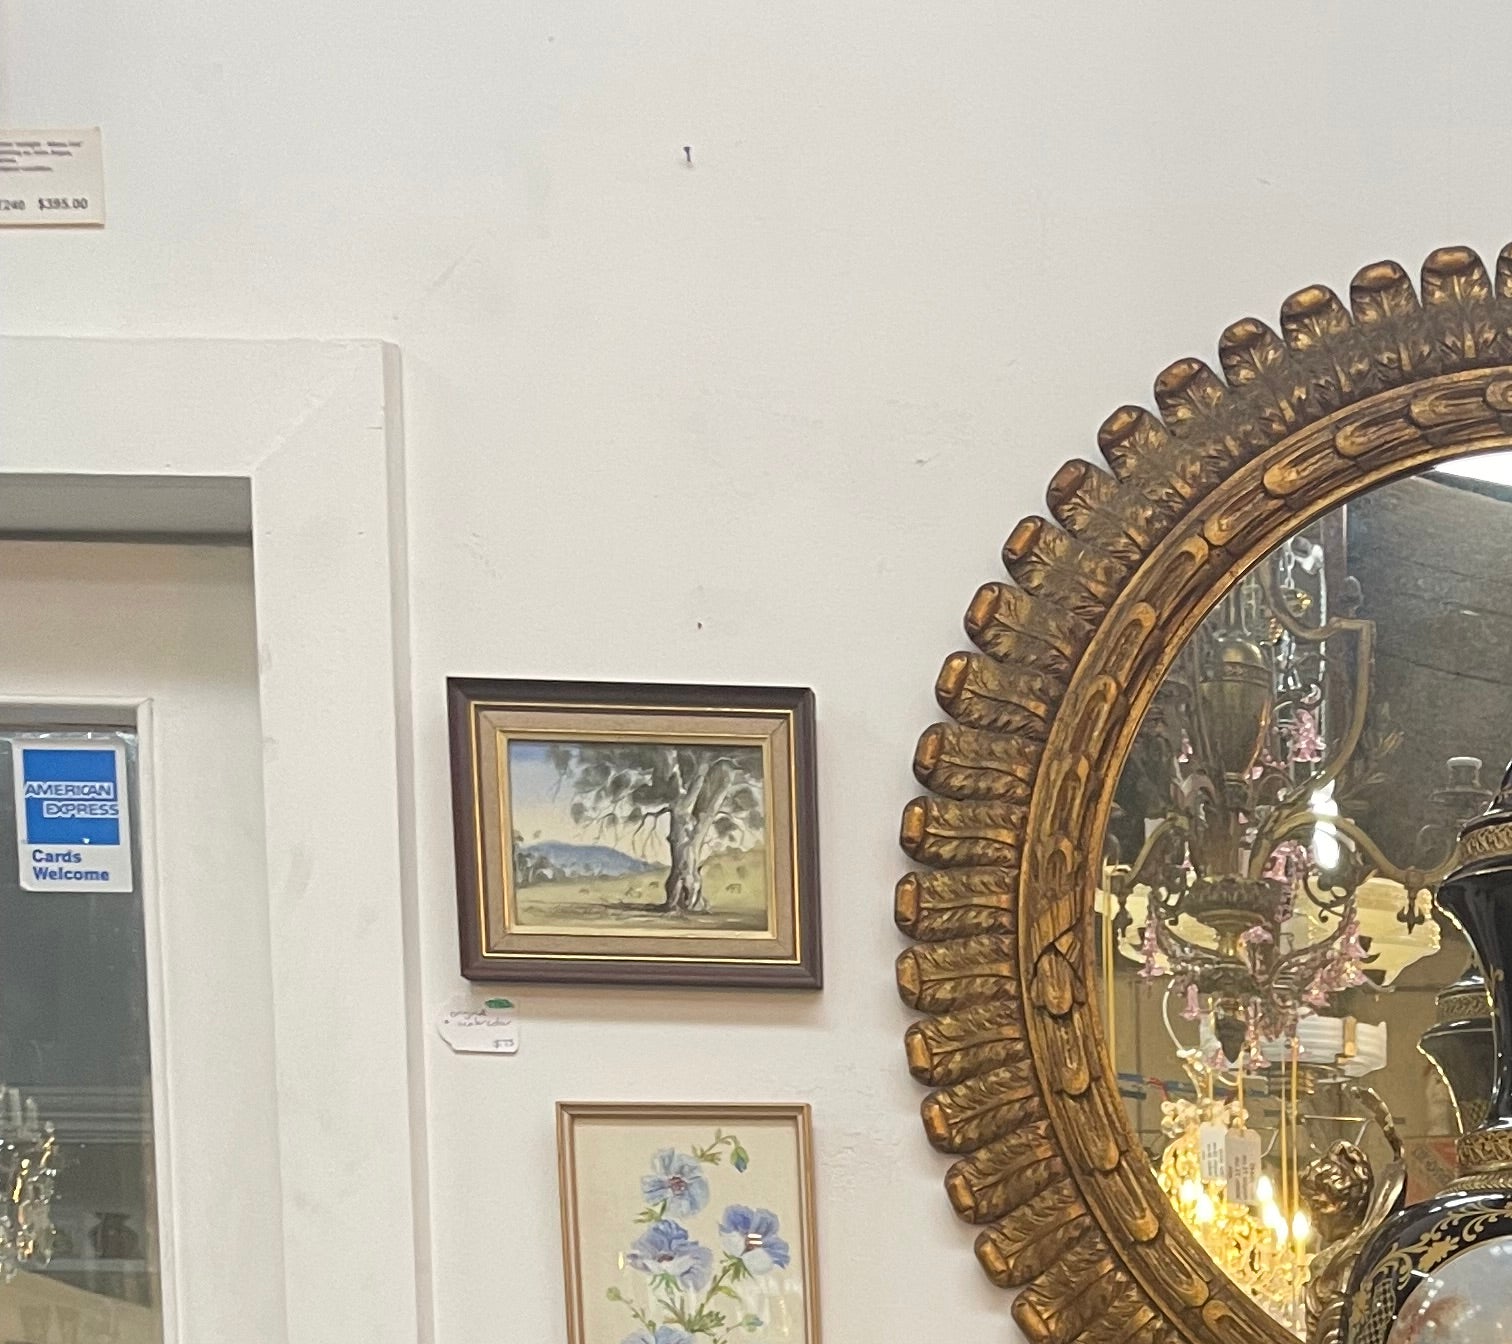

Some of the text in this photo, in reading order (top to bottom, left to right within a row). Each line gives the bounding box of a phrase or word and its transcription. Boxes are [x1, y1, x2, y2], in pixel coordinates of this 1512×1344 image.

[26, 784, 111, 797] AMERICAN
[46, 803, 119, 816] EXPRESS
[32, 850, 82, 864] Cards
[33, 866, 110, 881] Welcome
